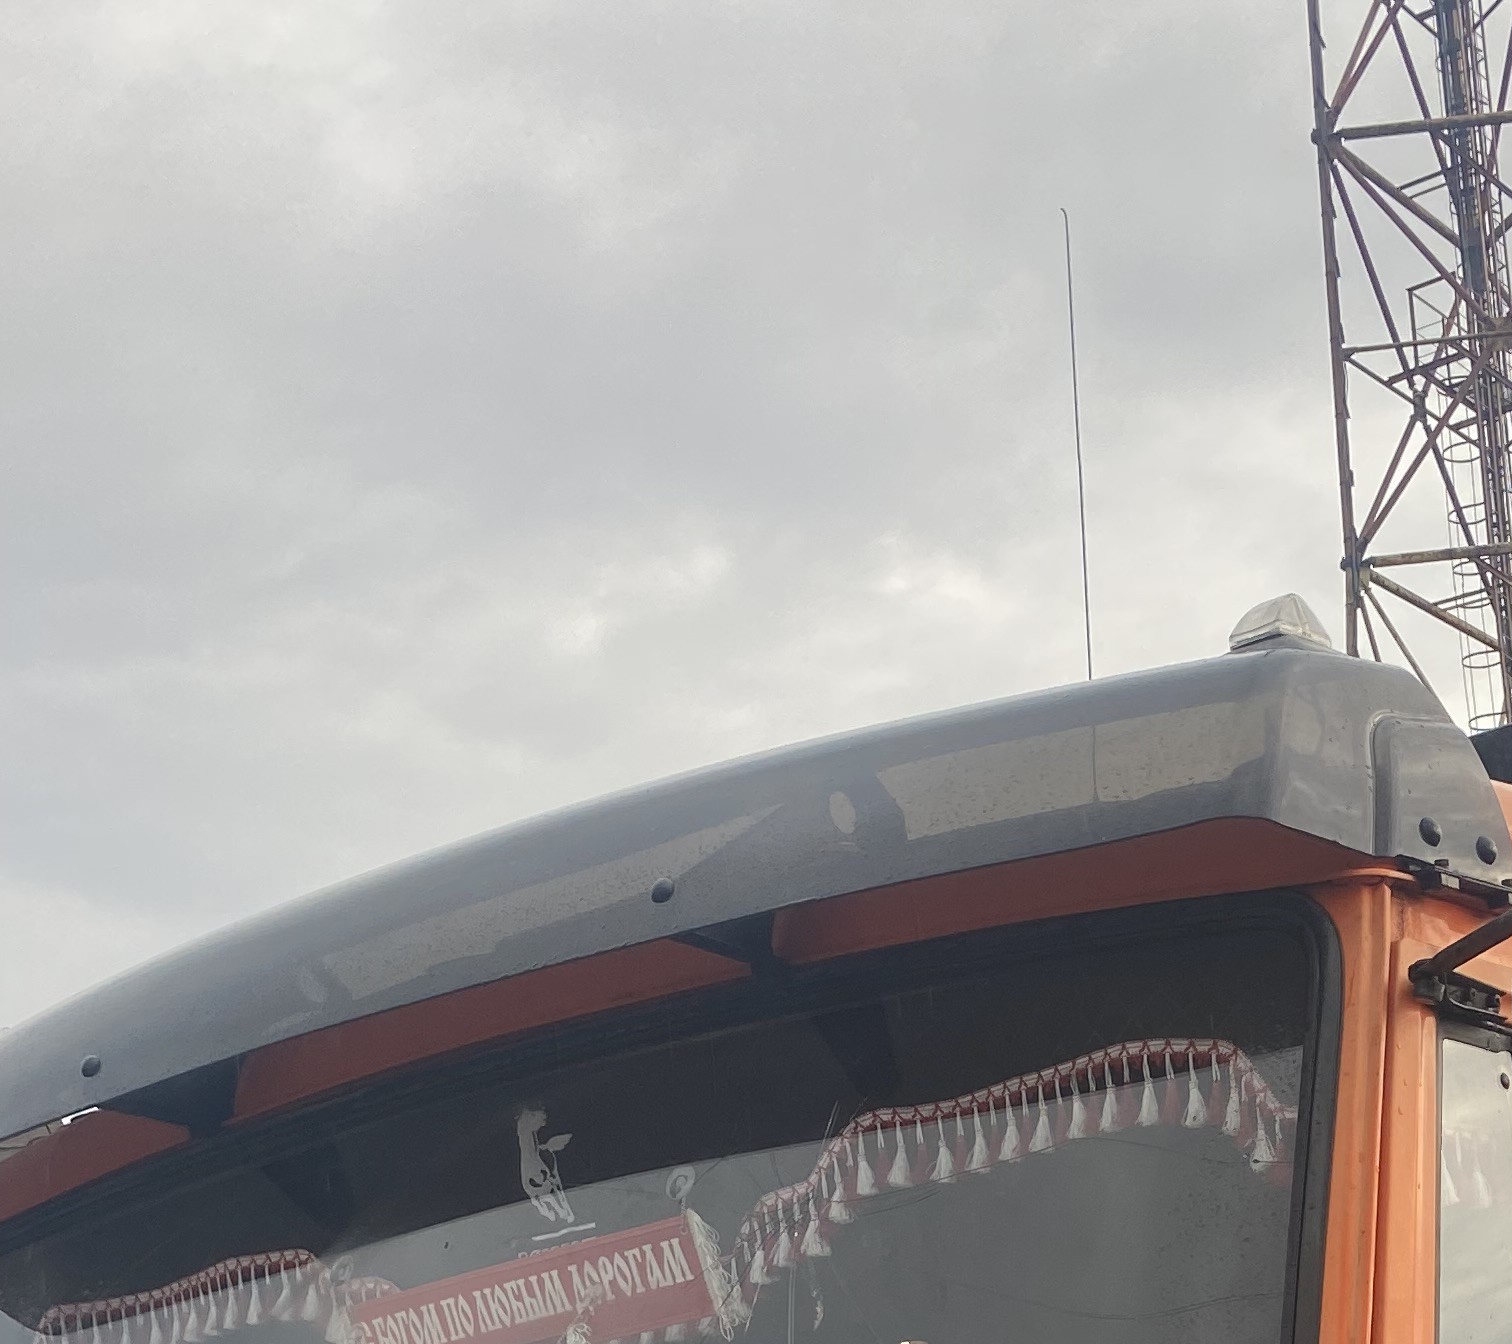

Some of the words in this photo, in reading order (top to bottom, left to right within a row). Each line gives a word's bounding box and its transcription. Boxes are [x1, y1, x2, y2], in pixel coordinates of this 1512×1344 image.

[440, 1293, 475, 1342] ПО
[472, 1268, 573, 1333] ЛЮБЫМ
[567, 1237, 696, 1312] ДОРОГАМ
